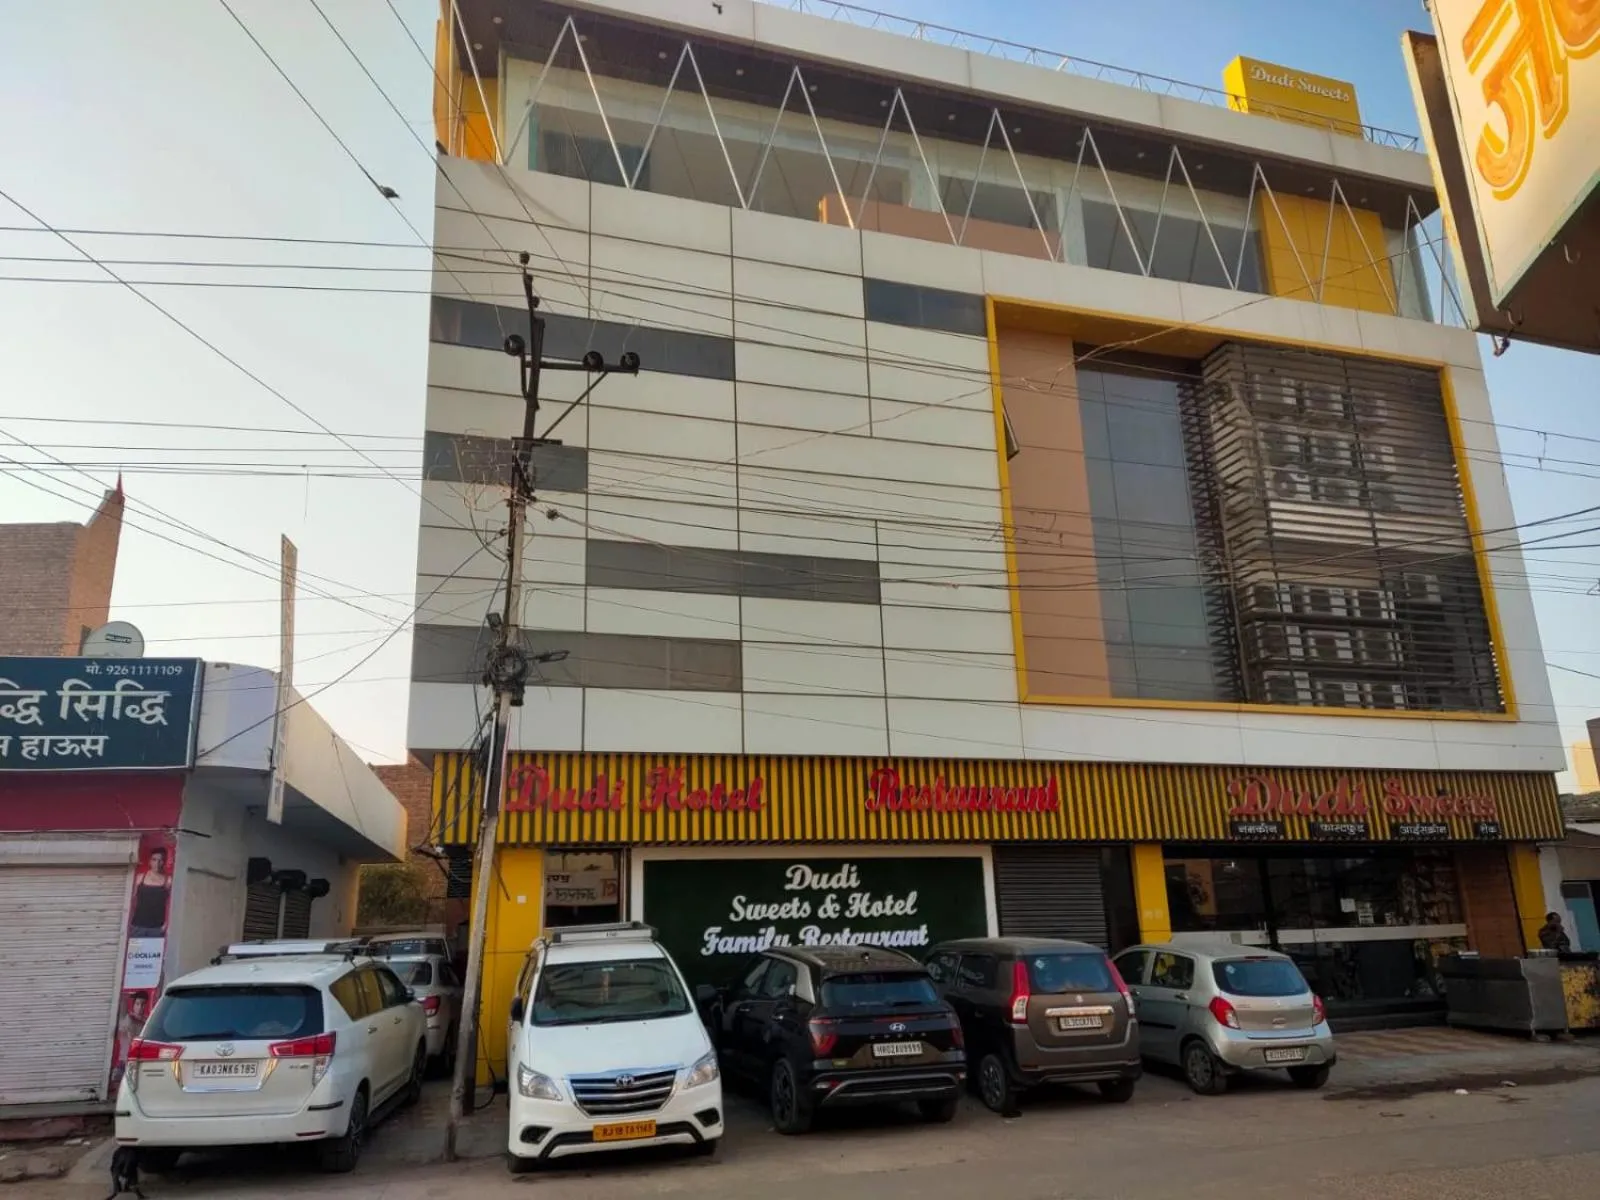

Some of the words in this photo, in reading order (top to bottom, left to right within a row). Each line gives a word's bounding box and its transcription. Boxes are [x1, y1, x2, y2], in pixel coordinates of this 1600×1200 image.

[1250, 65, 1295, 88] Dudi
[1297, 77, 1349, 102] Sweets
[56, 678, 172, 726] सिद्धि
[19, 735, 110, 760] हाऊस
[505, 763, 627, 813] Dudi
[639, 766, 767, 813] Hotel
[865, 767, 1060, 813] Restaurant
[1228, 773, 1368, 816] Dudi
[1383, 777, 1497, 817] Sweets
[784, 864, 861, 890] Dudi
[729, 895, 812, 921] Sweets
[817, 893, 840, 919] &
[844, 891, 918, 919] Hotel
[797, 924, 930, 947] Restaurant
